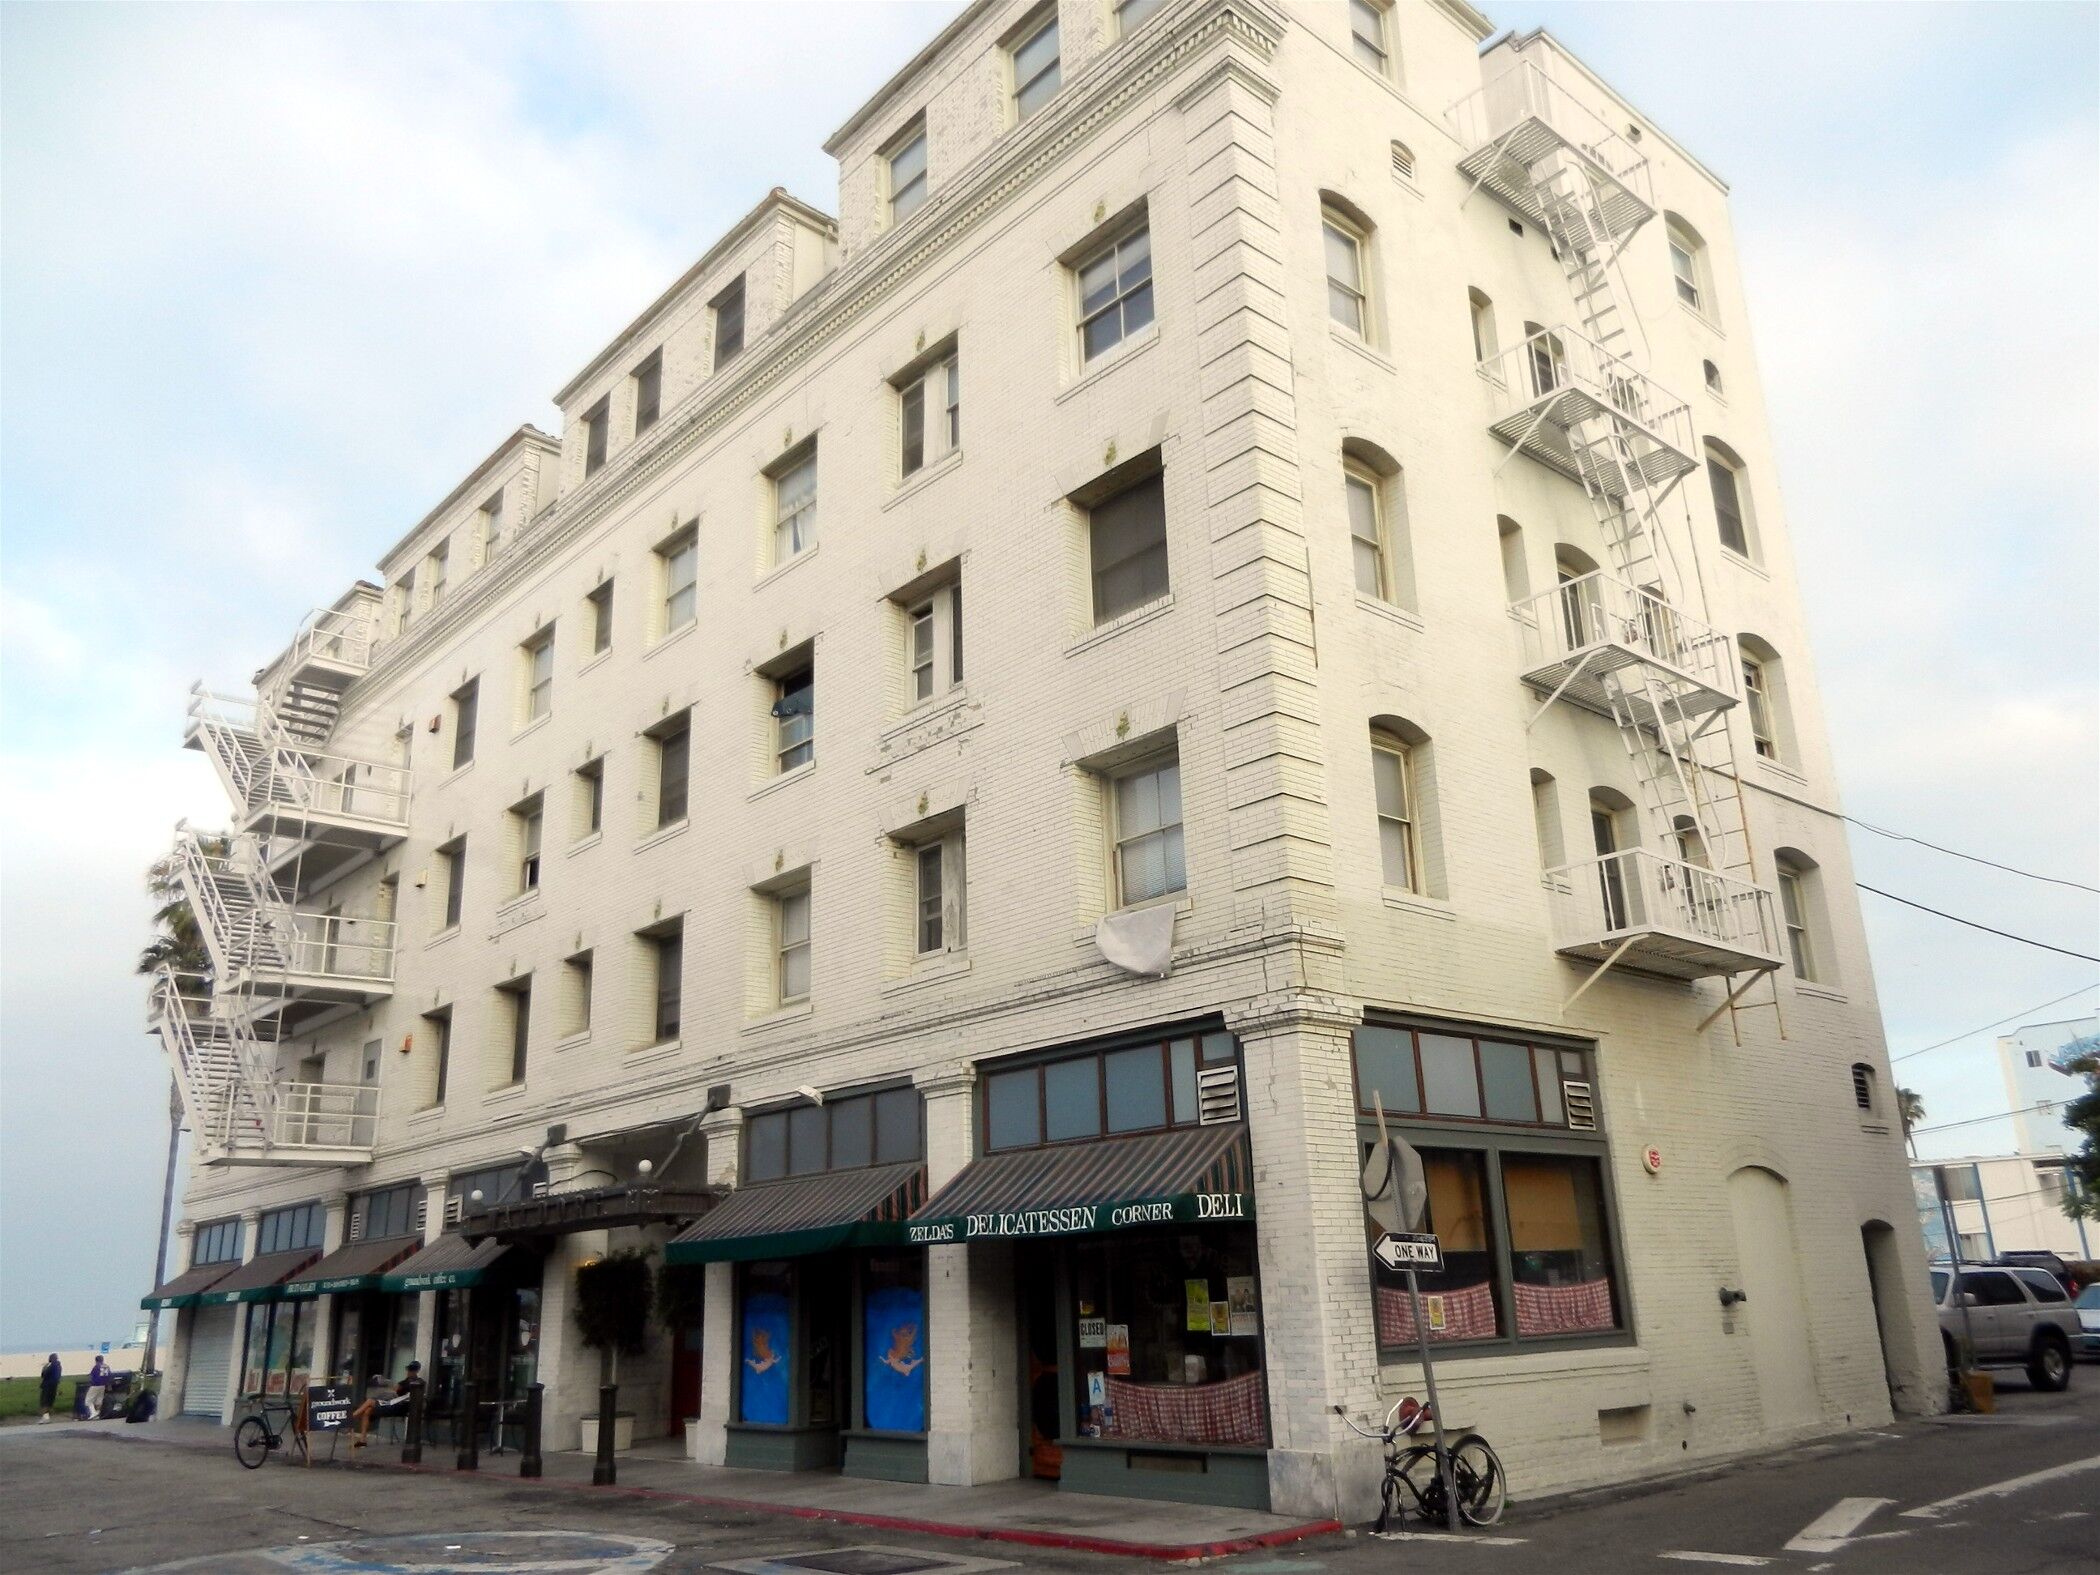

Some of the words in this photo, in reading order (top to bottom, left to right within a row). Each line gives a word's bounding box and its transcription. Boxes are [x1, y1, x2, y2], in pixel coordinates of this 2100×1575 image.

[1196, 1193, 1243, 1218] DELI
[966, 1206, 1097, 1236] DELICATESSEN
[1111, 1202, 1173, 1226] CORNER
[909, 1224, 954, 1241] ZELDA'S
[1394, 1244, 1414, 1258] ONE
[1415, 1246, 1434, 1259] WAY
[1080, 1322, 1105, 1336] CLOSED
[1092, 1378, 1102, 1394] A
[316, 1410, 347, 1421] COFFEE
